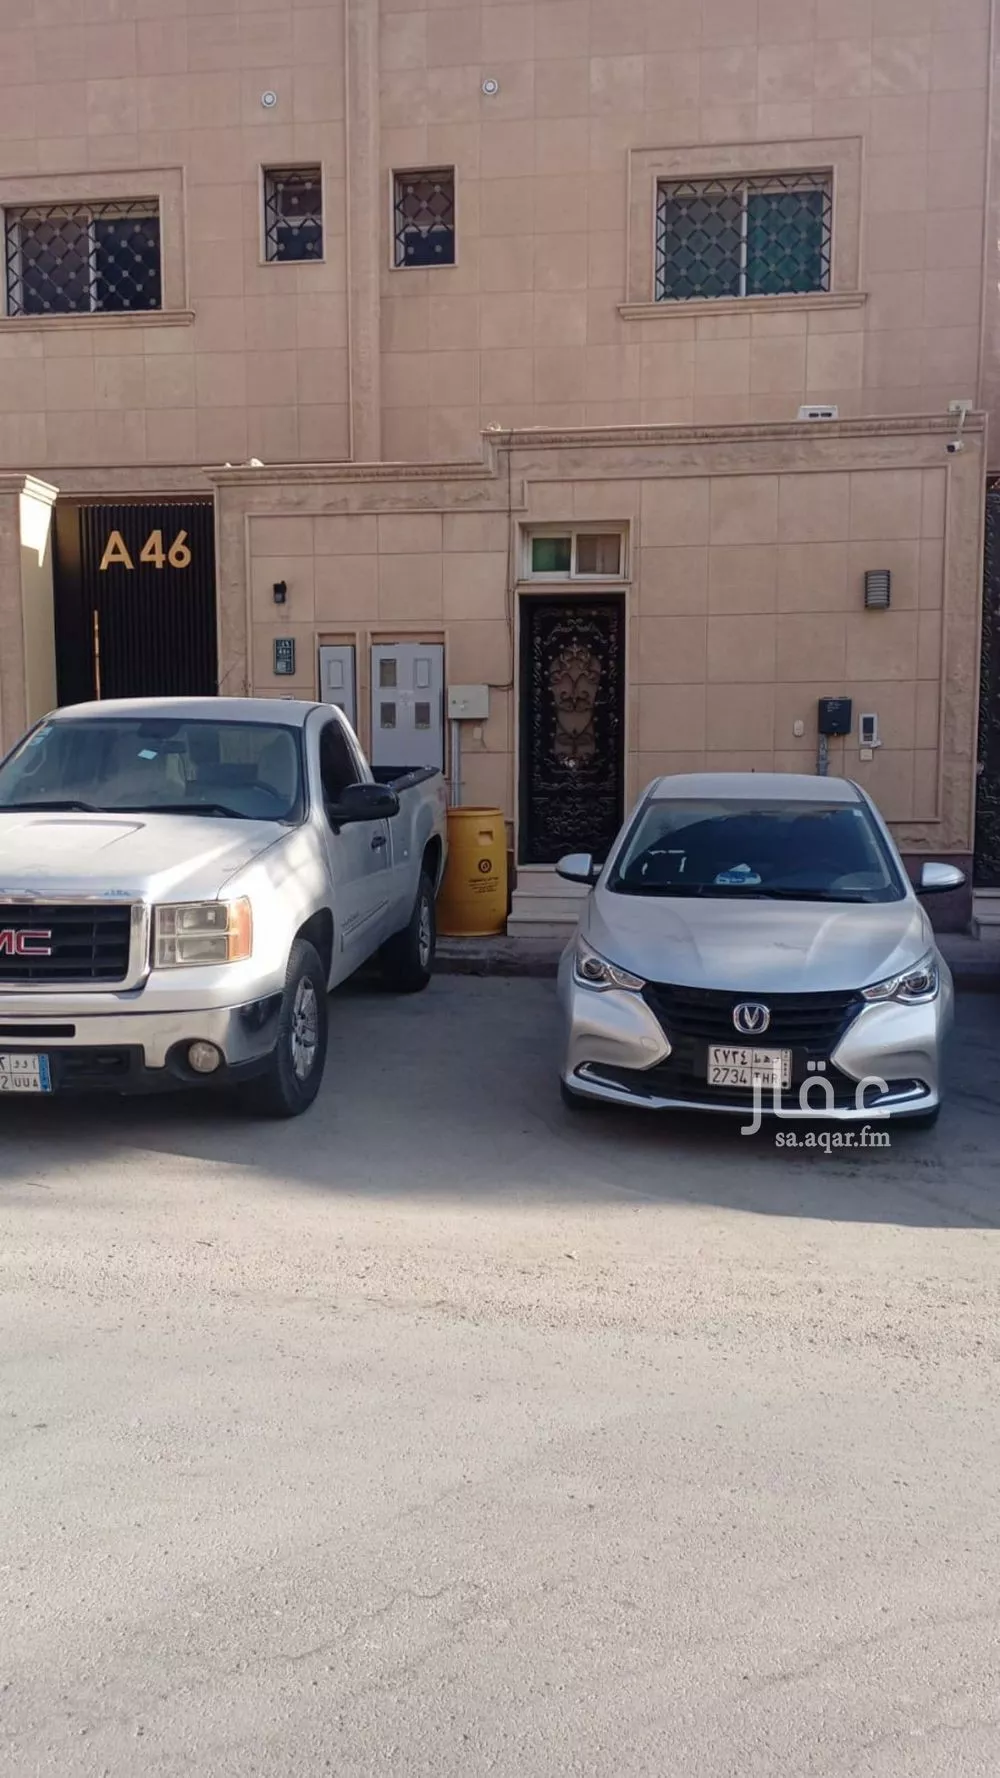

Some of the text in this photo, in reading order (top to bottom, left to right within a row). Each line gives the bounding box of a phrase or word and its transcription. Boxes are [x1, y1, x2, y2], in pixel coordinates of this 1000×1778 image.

[100, 529, 192, 569] A 46
[713, 1067, 747, 1084] 2734
